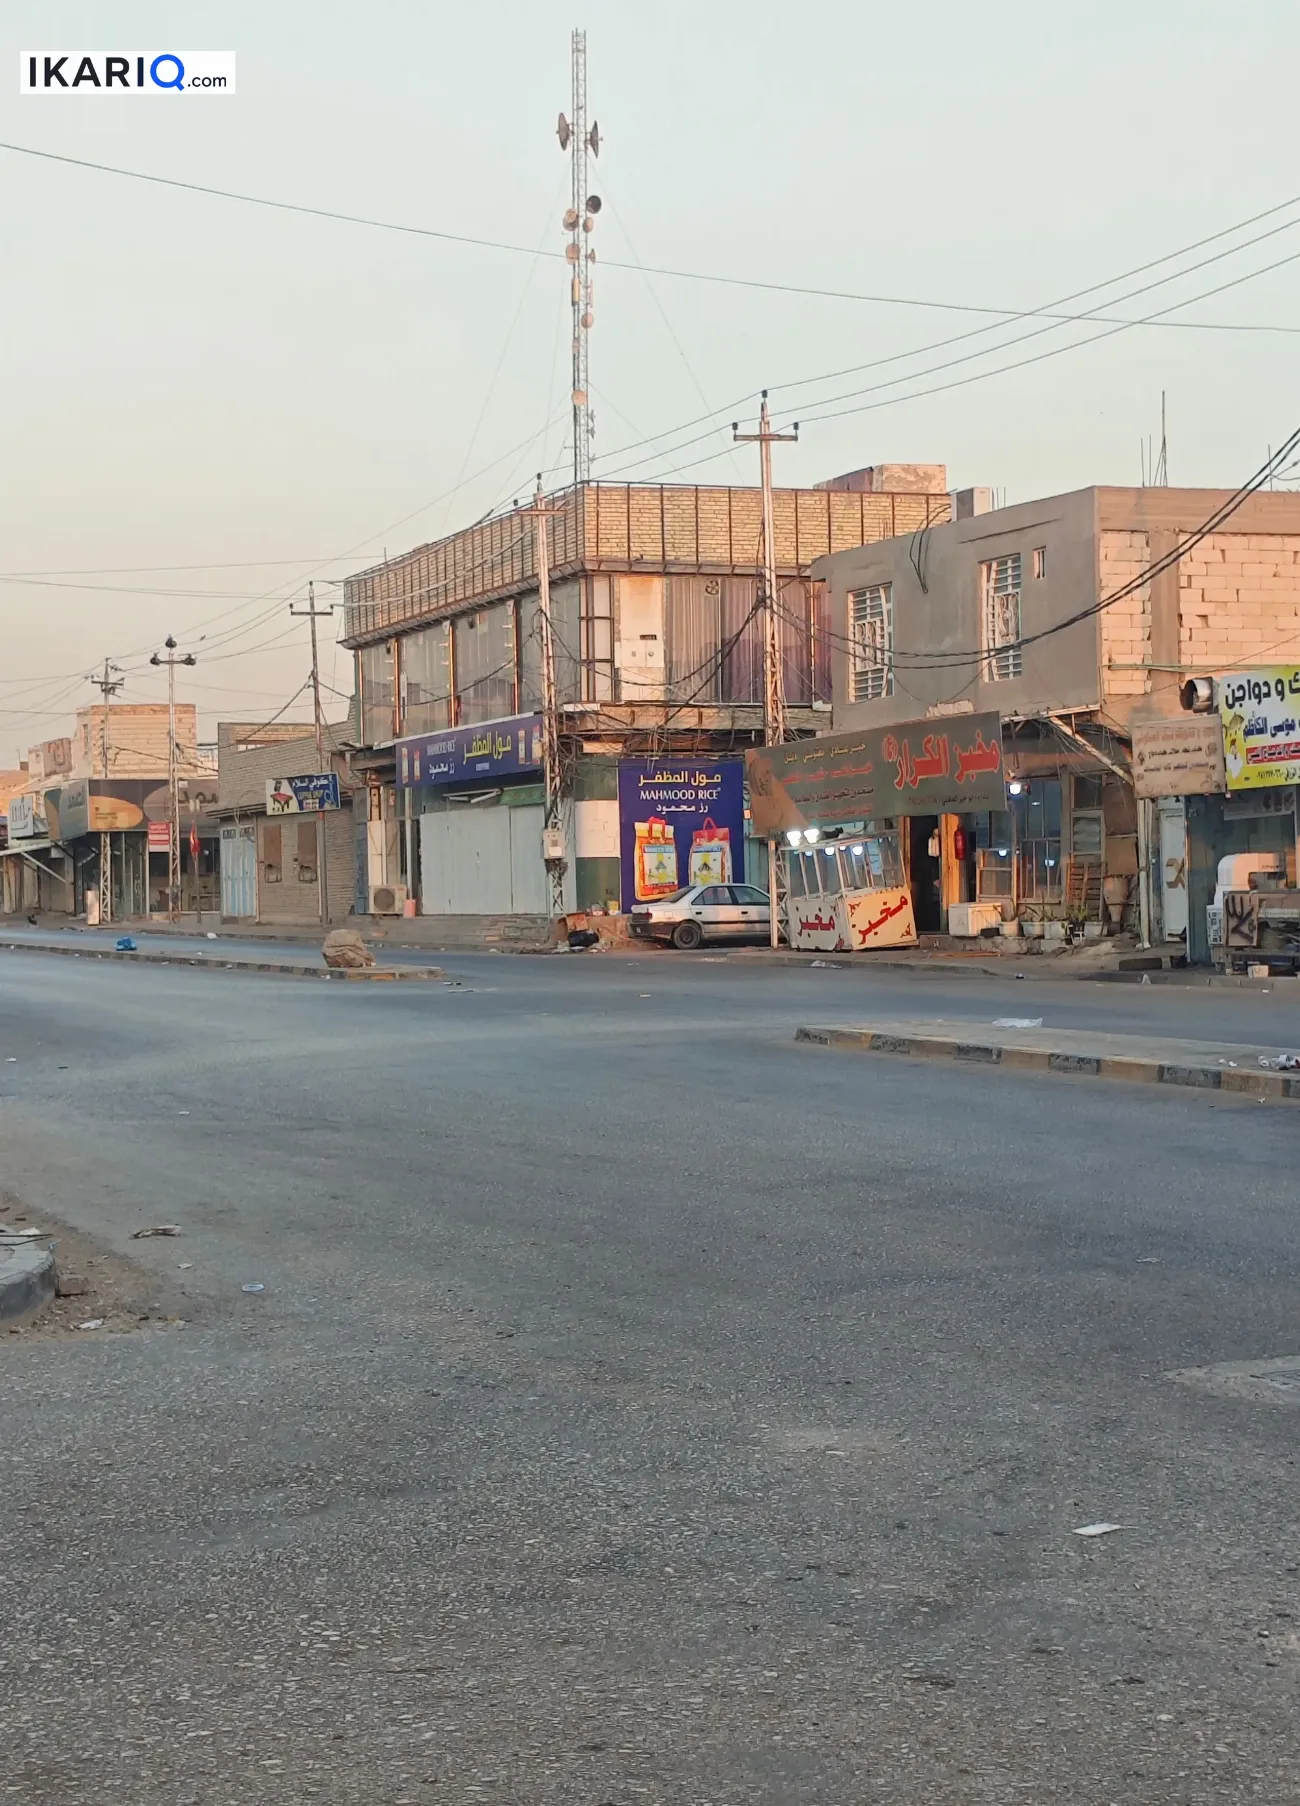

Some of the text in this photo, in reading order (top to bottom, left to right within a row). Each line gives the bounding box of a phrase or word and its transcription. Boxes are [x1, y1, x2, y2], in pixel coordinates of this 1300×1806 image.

[1225, 679, 1271, 709] دواجن
[1274, 678, 1285, 702] و
[1243, 716, 1268, 743] الكاظم
[1270, 717, 1296, 738] موسى
[463, 731, 512, 766] مول المظفر
[893, 733, 950, 791] الكرار
[953, 730, 1001, 784] مخبز
[428, 762, 449, 779] محمود
[638, 770, 722, 787] مول المظفر
[640, 789, 696, 800] MAHMOOD
[656, 802, 709, 815] رز محمود
[795, 906, 836, 938] مخبز
[852, 895, 909, 945] مخبز
